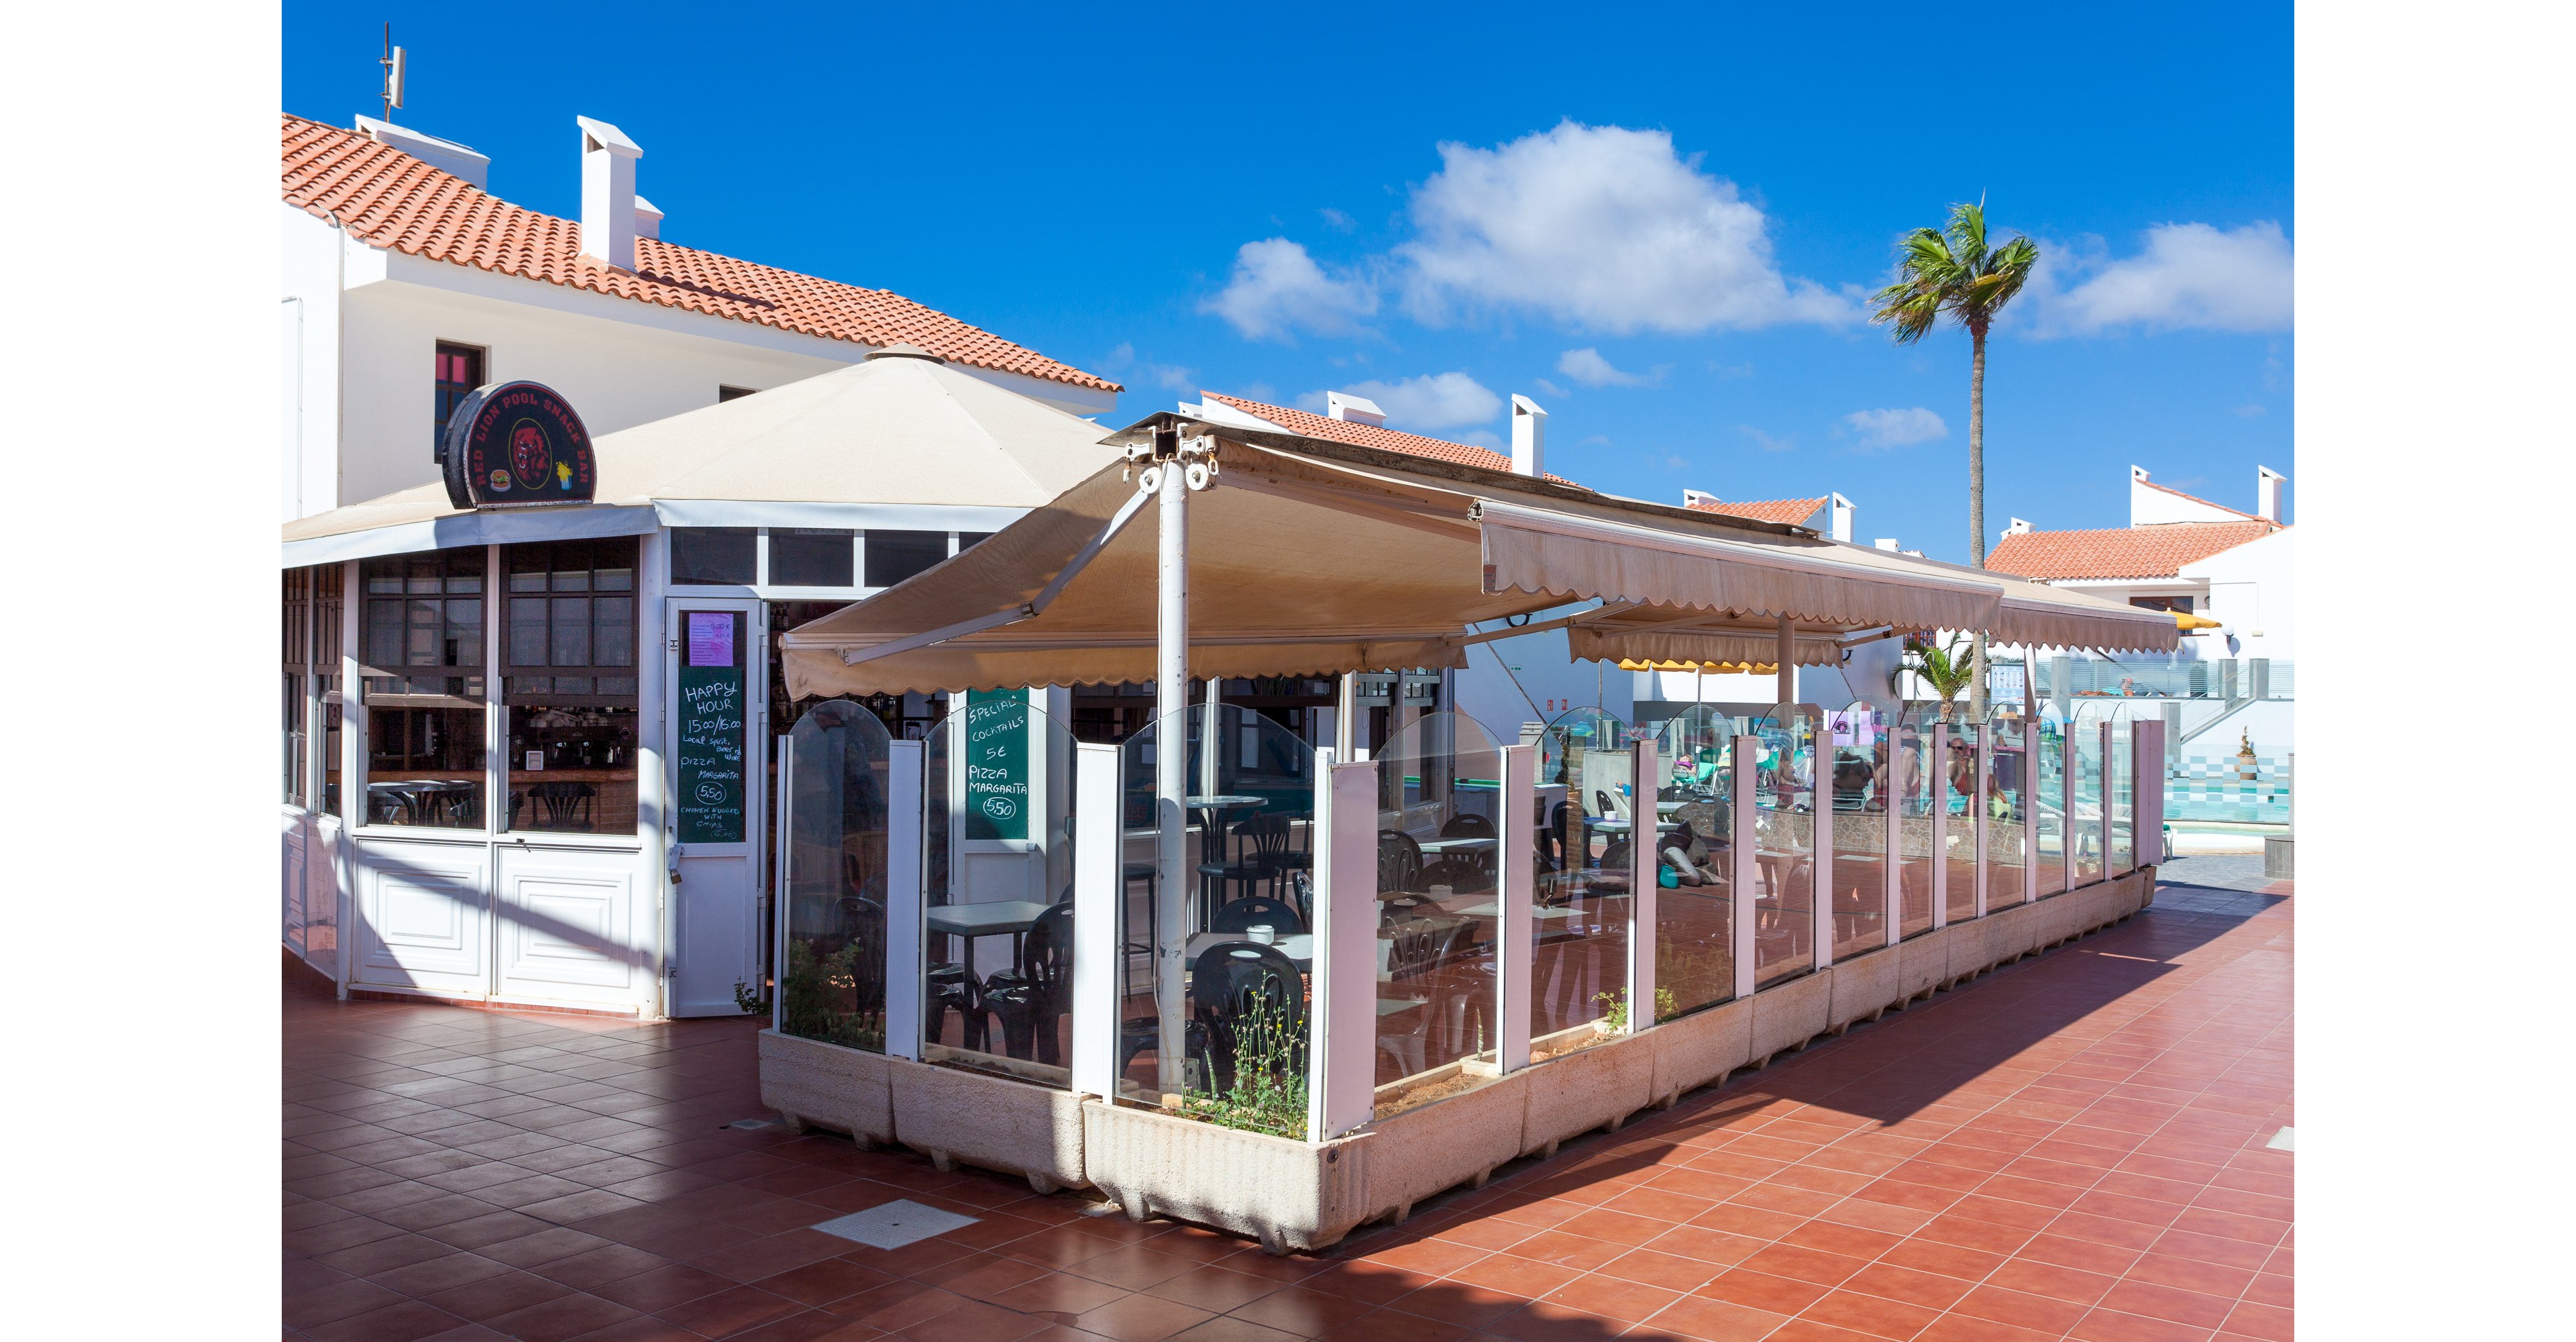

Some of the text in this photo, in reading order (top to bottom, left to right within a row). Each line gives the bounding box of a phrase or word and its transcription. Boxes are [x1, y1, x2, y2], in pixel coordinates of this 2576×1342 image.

[474, 393, 588, 486] RED LION POOL SNACK BAR
[685, 681, 738, 703] HAPPY
[697, 699, 734, 715] HOUR
[683, 734, 705, 745] Local
[681, 757, 716, 769] PIZZA
[969, 765, 1008, 780] PIZZA
[986, 799, 1012, 815] 5,50
